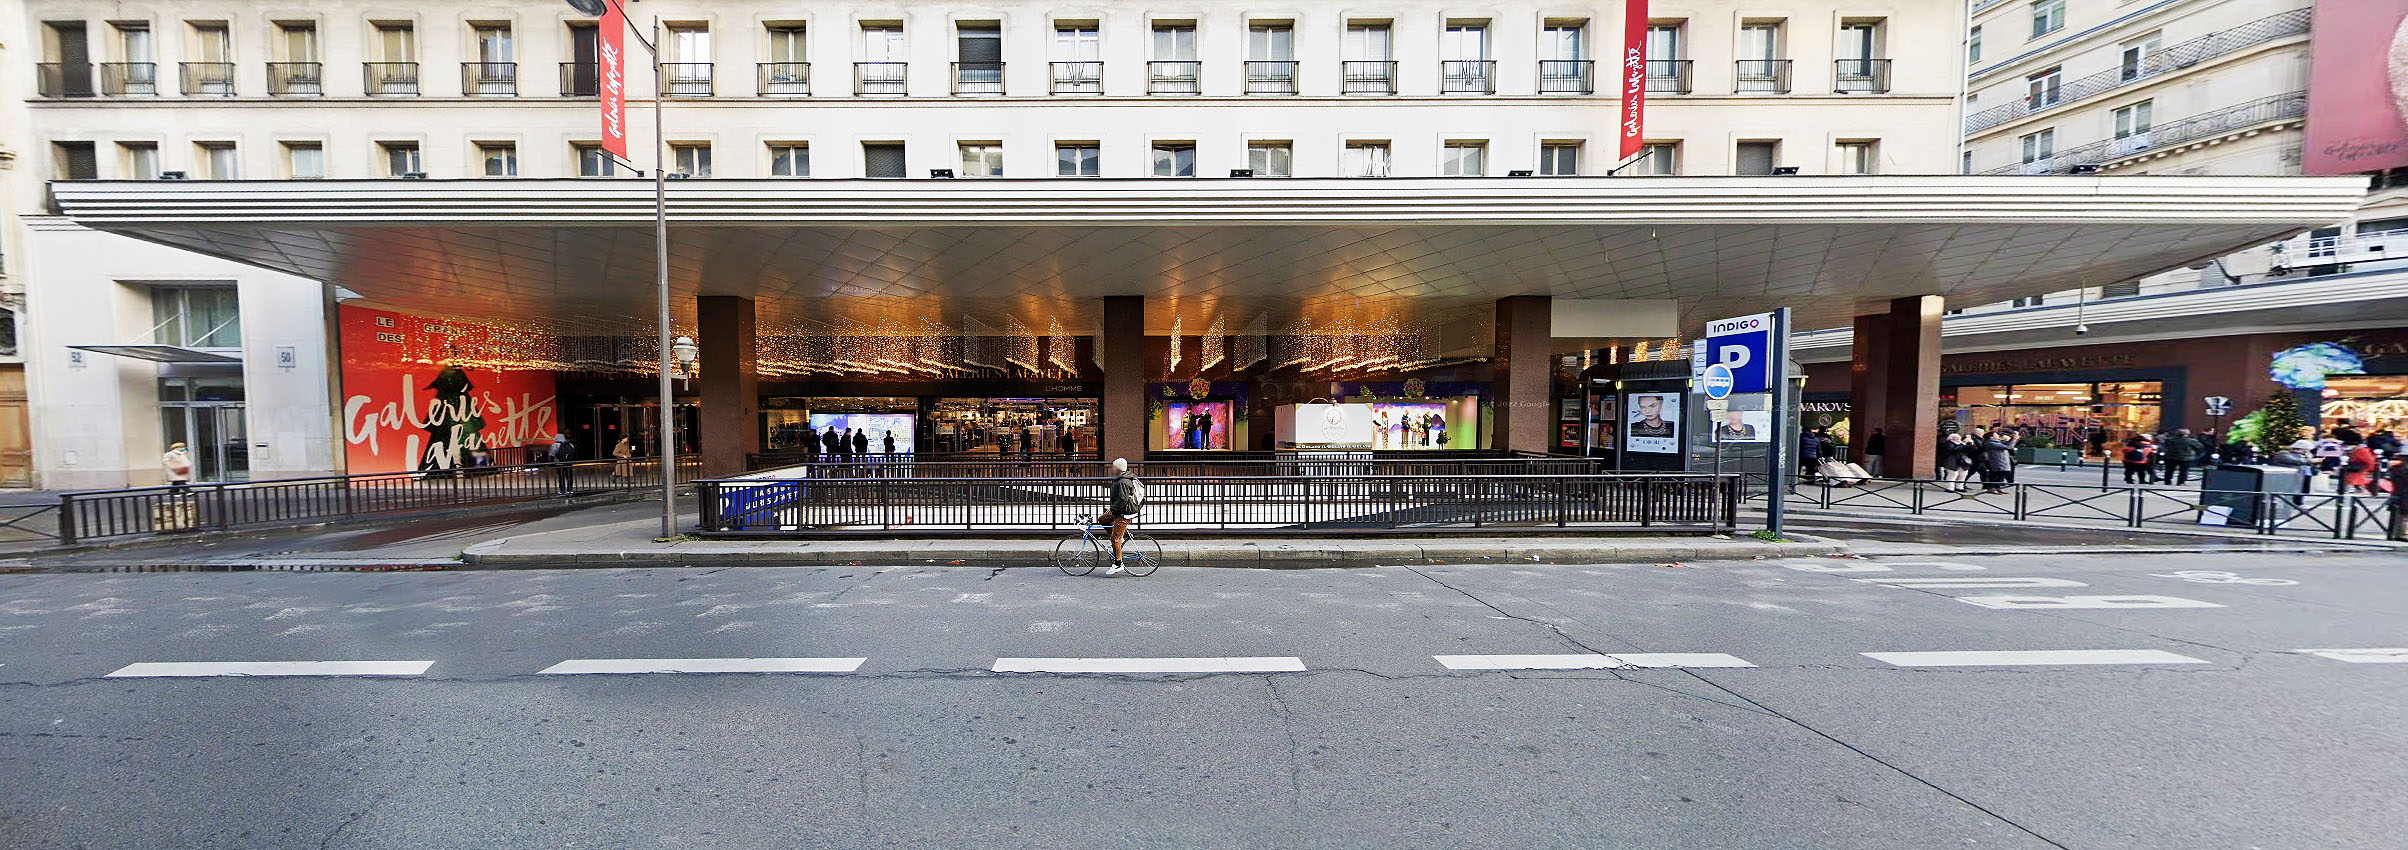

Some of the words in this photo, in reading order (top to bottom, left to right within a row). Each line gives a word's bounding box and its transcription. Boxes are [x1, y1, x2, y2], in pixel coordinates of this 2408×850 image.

[377, 317, 394, 327] LE
[1713, 319, 1759, 333] INDIGO
[378, 333, 402, 342] DES
[281, 351, 290, 362] 50
[1720, 344, 1750, 369] P
[344, 374, 502, 457] Galeries
